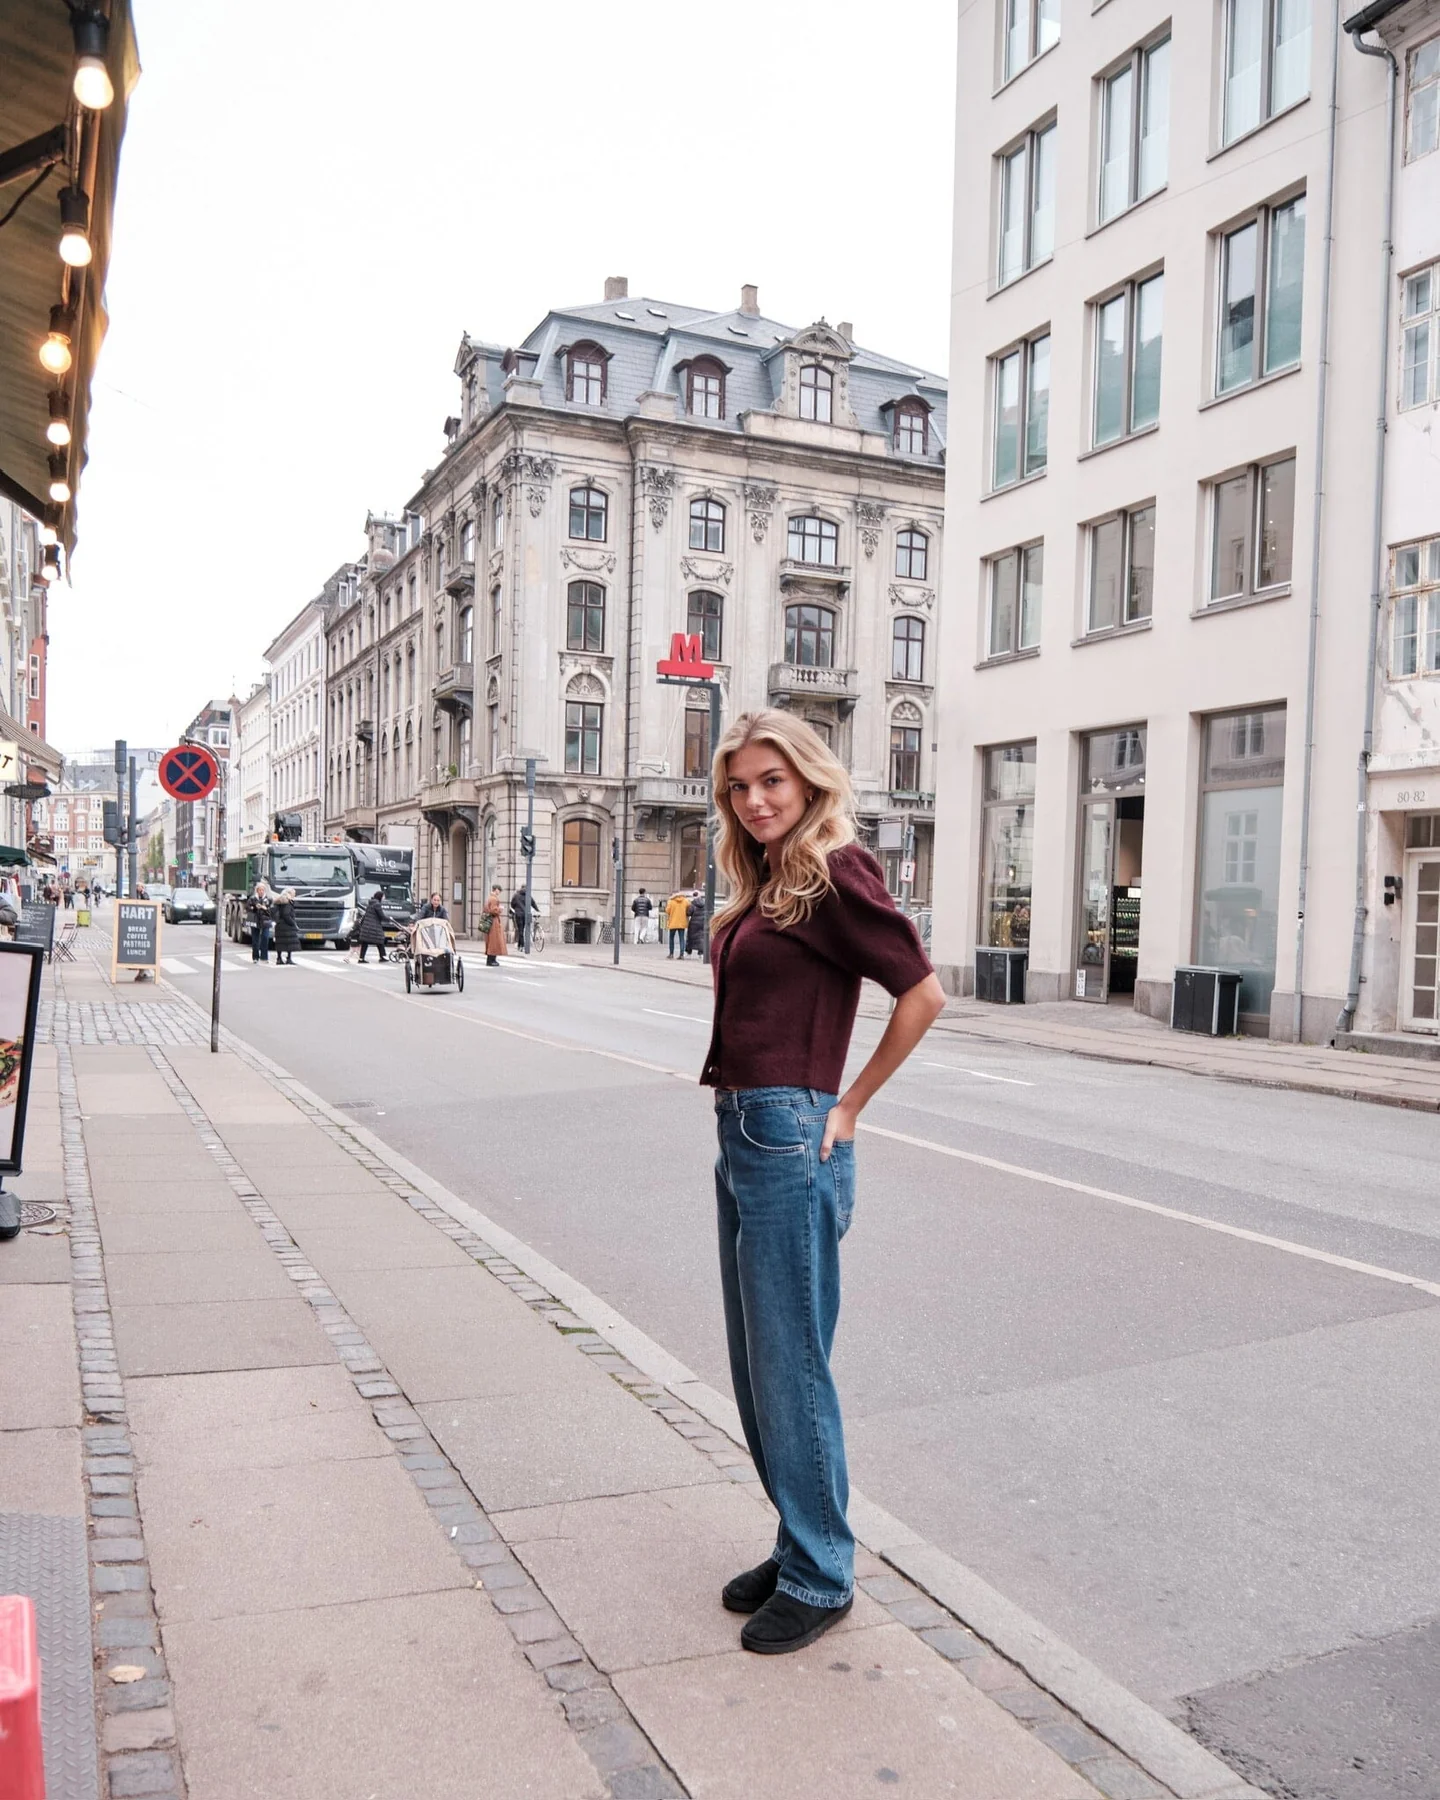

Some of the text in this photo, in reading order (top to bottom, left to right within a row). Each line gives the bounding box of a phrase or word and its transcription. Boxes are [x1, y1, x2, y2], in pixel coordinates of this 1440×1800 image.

[670, 633, 702, 663] M
[121, 906, 155, 920] HART
[128, 925, 147, 933] BREAD
[123, 940, 151, 948] PASTRIES
